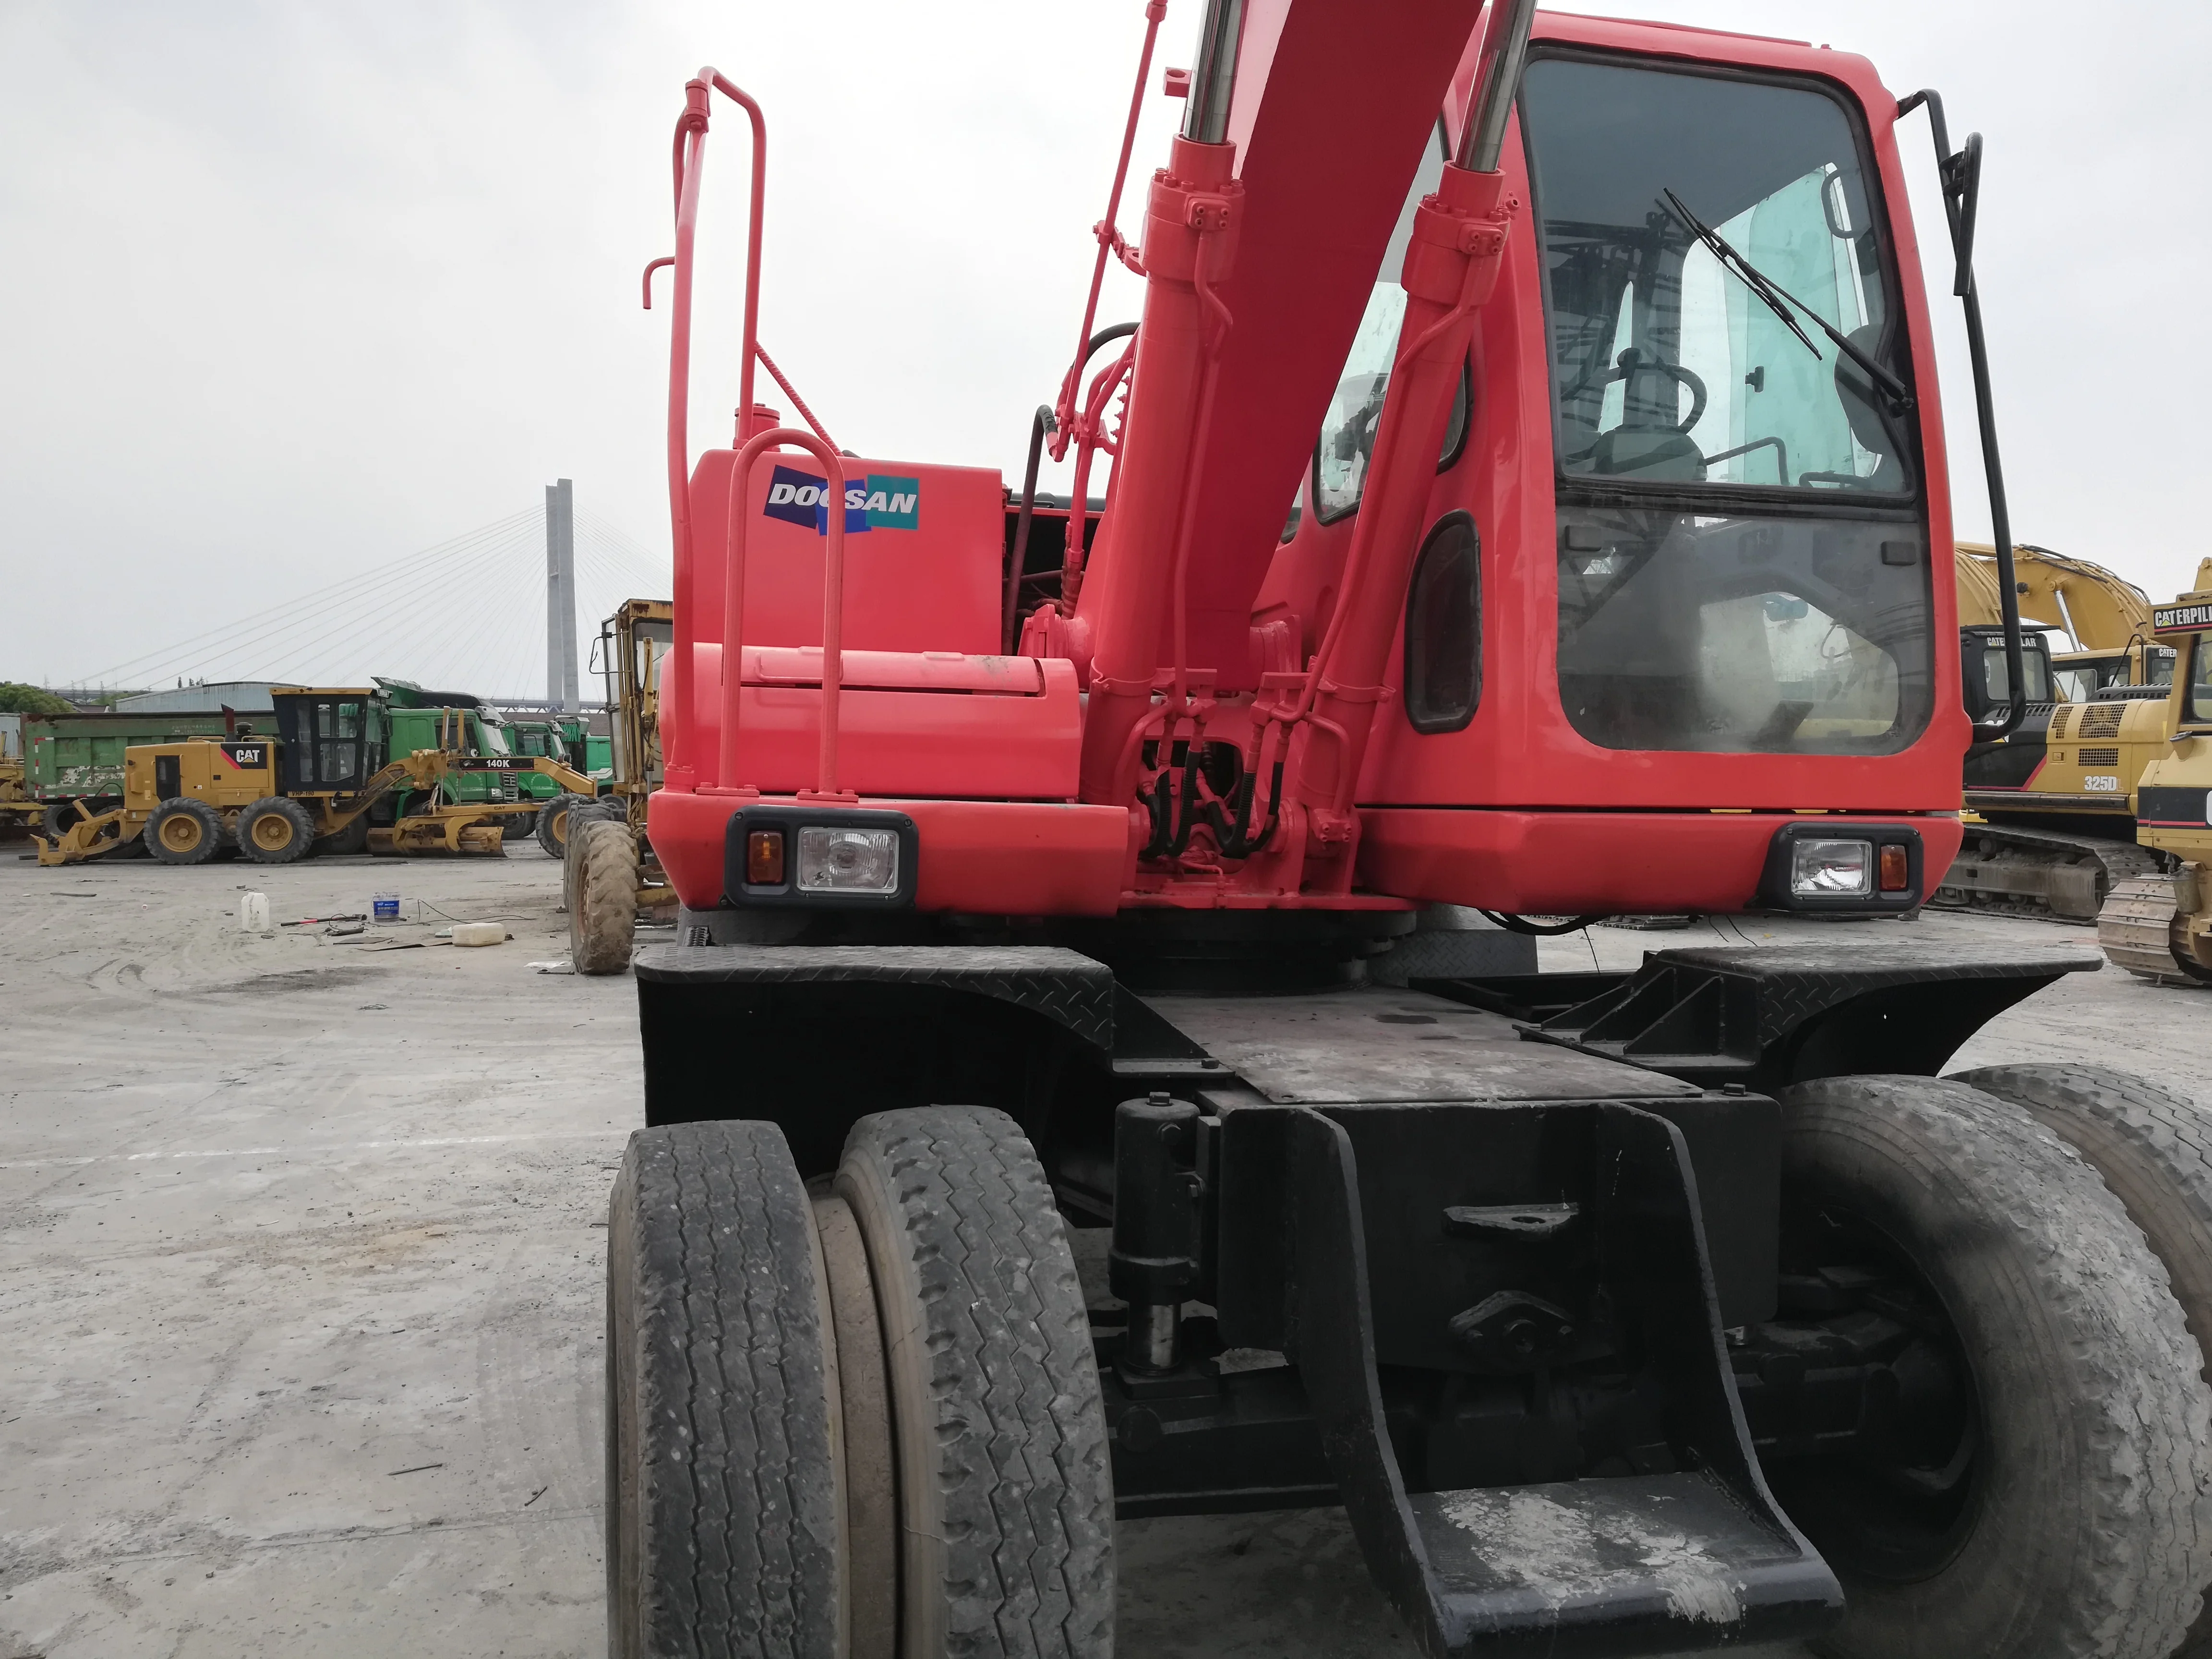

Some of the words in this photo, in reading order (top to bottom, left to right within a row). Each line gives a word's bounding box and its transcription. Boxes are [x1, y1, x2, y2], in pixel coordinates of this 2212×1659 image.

[1987, 637, 2036, 647] CATELAR
[236, 750, 260, 763] CAT
[486, 759, 510, 768] 140K
